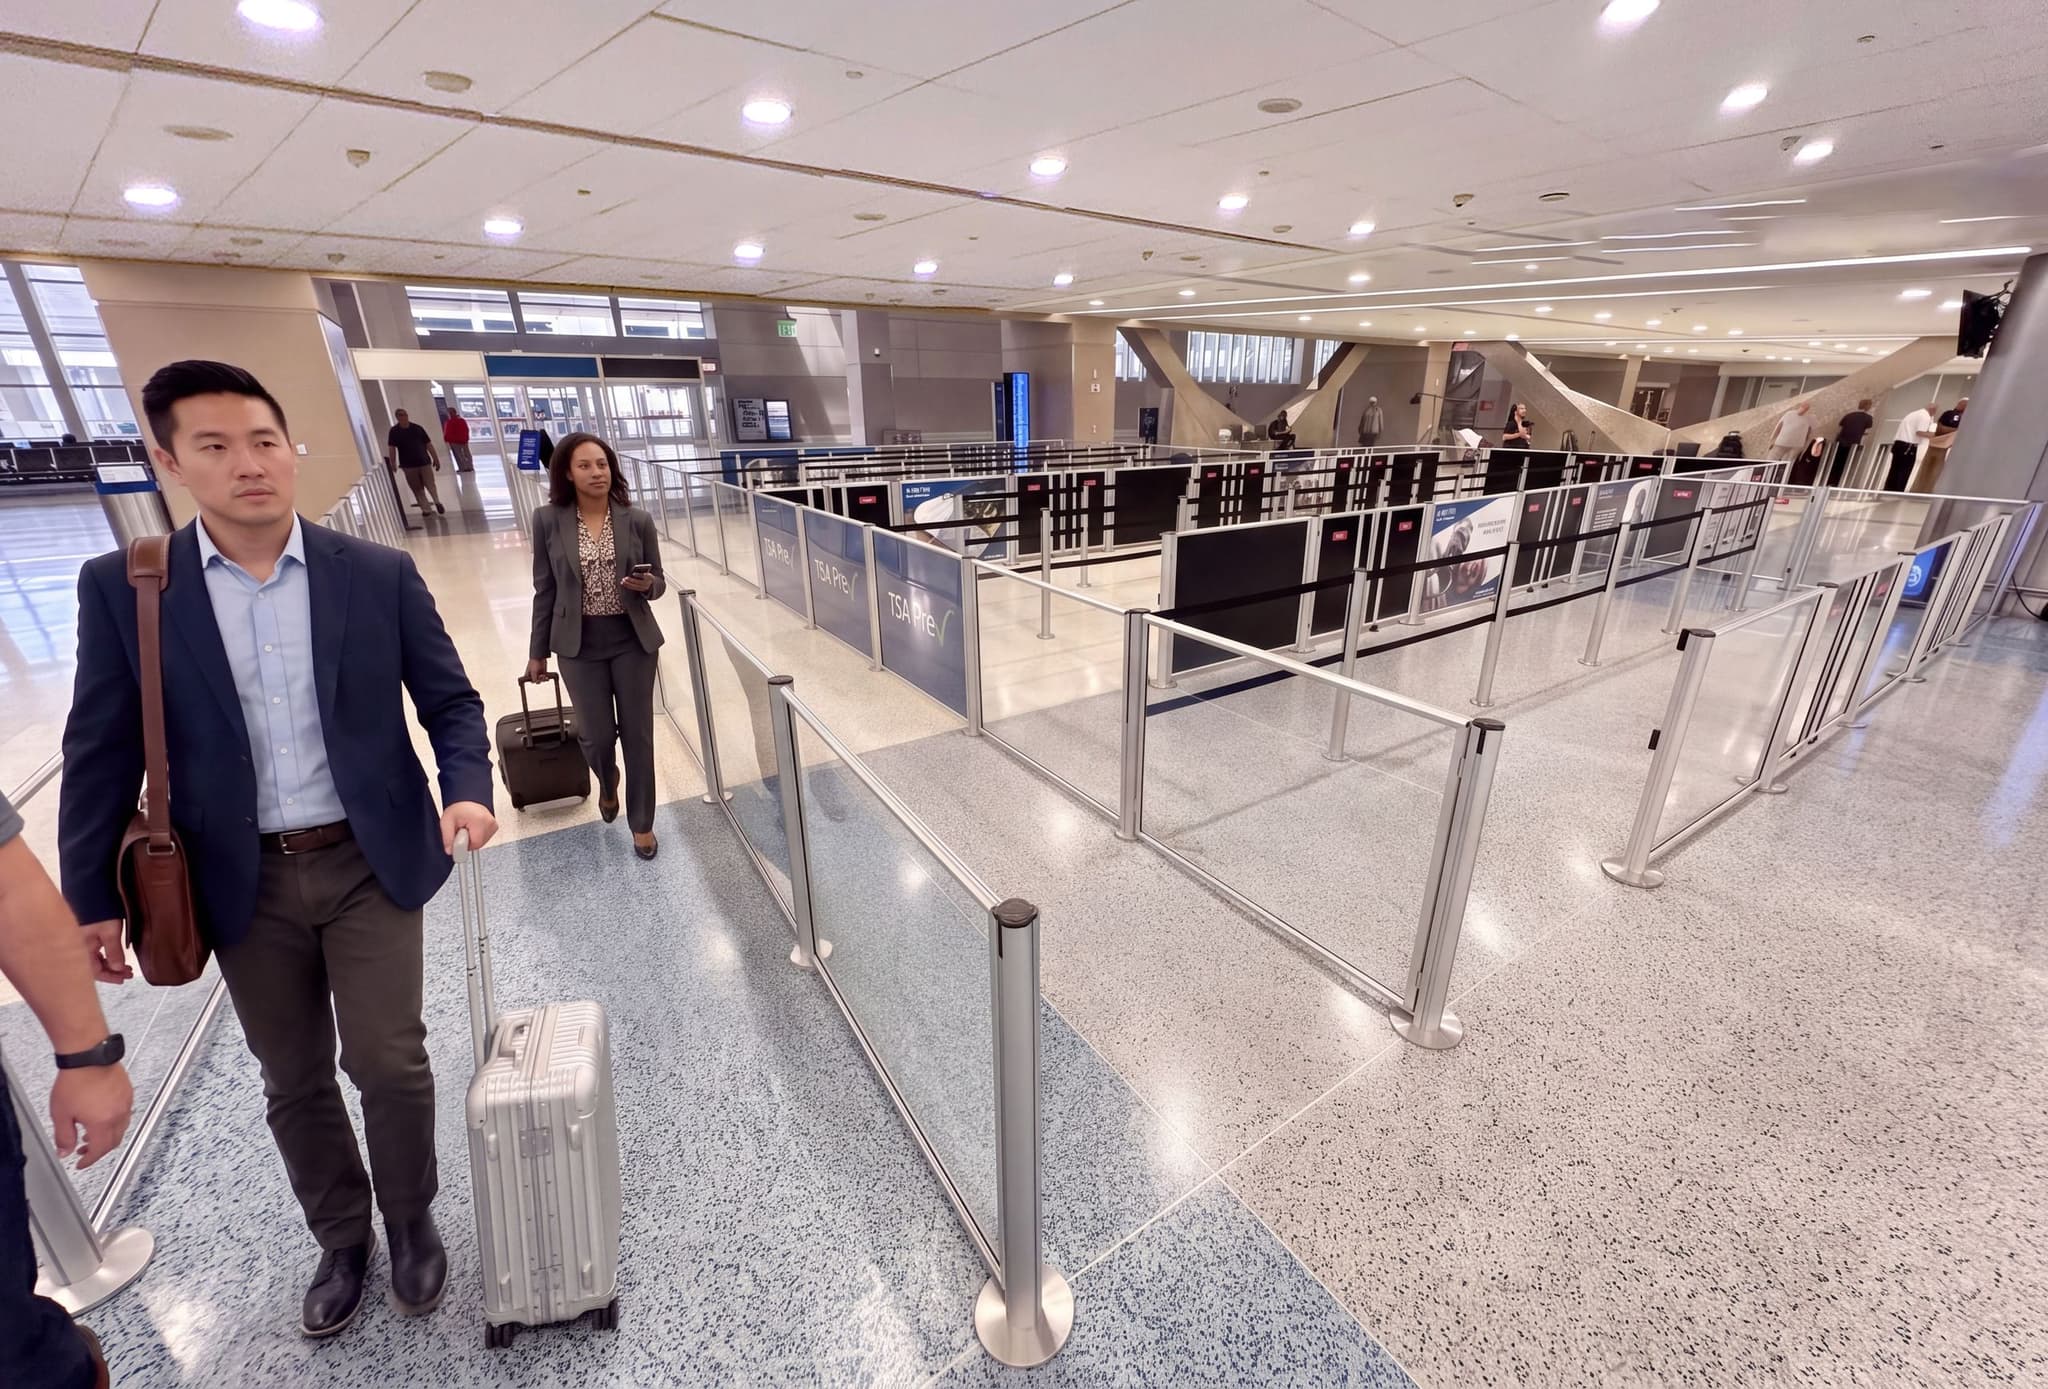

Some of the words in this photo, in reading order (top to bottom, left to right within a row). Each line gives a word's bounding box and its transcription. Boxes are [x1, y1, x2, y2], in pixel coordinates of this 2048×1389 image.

[814, 557, 832, 585] TSA
[832, 566, 849, 594] Pre
[888, 591, 911, 624] TSA
[911, 601, 935, 637] Pre
